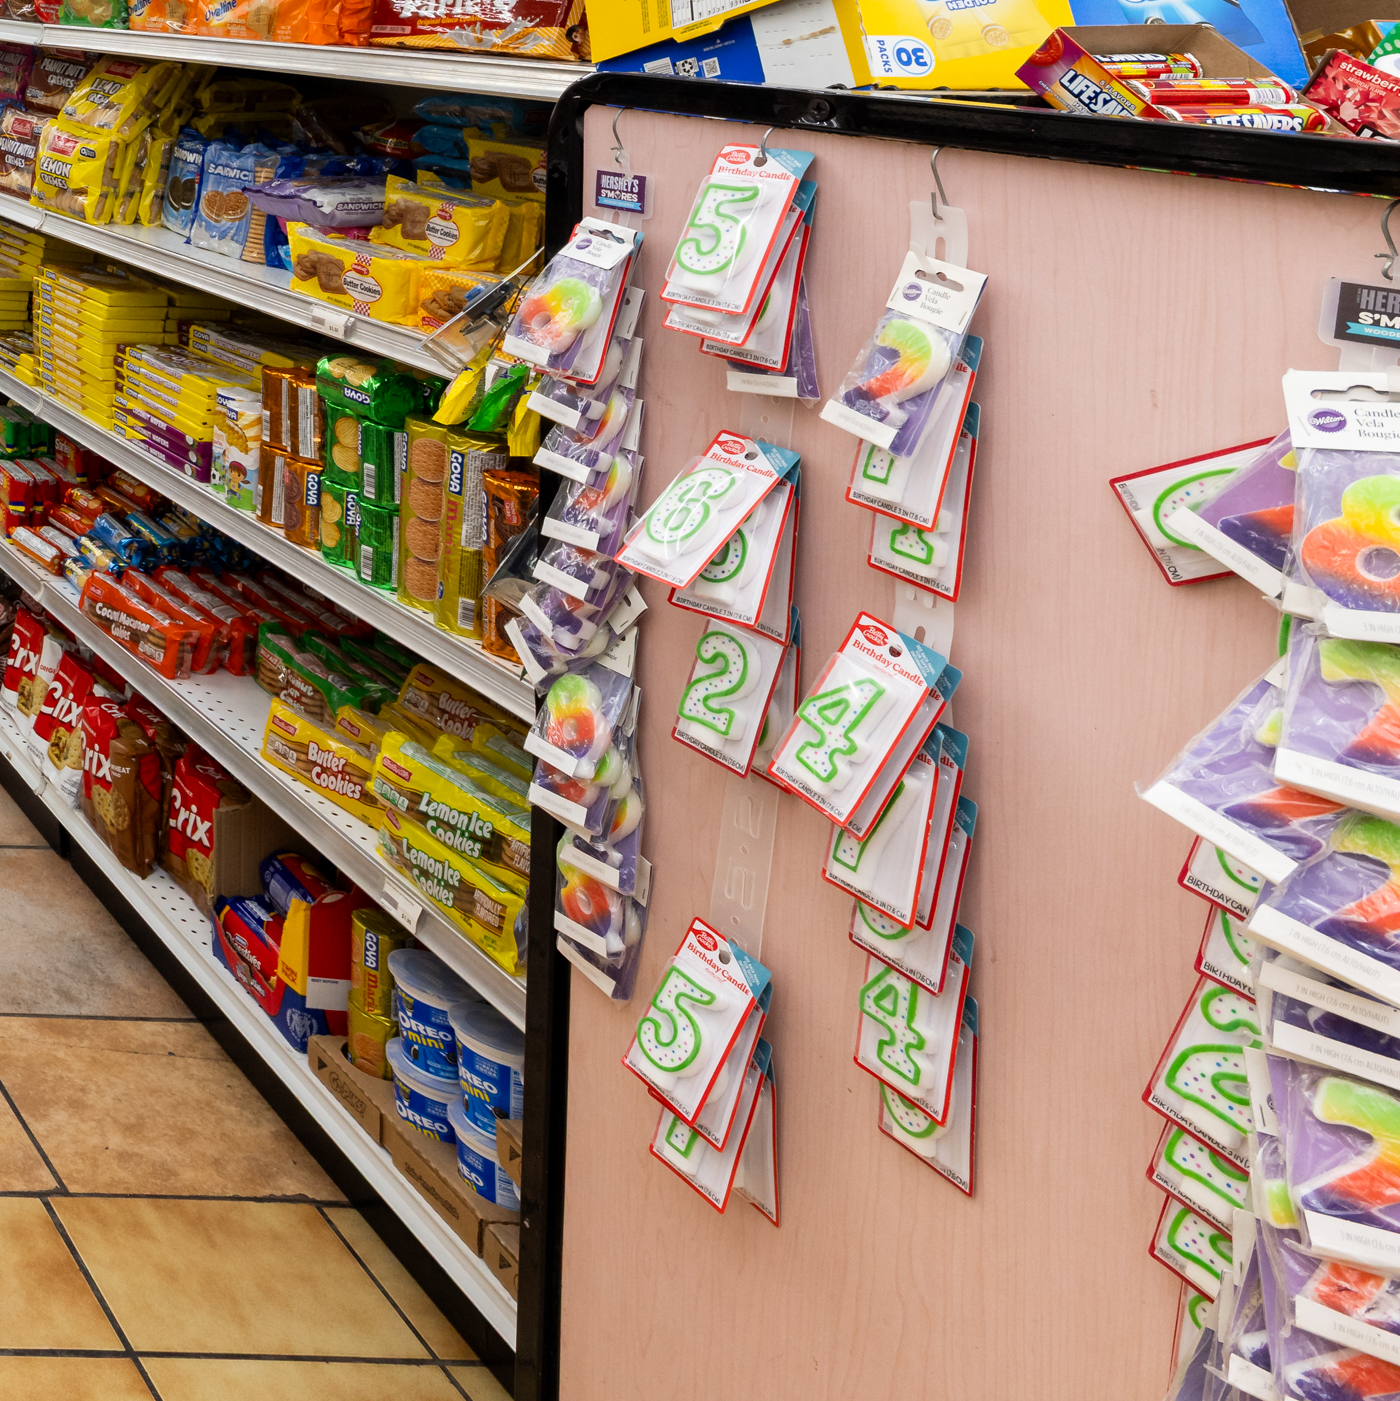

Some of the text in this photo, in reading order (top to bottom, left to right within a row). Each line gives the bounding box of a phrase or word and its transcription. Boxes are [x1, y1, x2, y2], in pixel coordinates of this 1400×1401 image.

[876, 39, 894, 74] PACKS
[1107, 83, 1136, 111] FLAVORS
[40, 157, 72, 179] LEMON
[717, 166, 792, 181] Birthday Candle
[601, 175, 639, 192] HERSHEY'S
[336, 202, 385, 211] SANDWICH
[601, 189, 638, 202] S'MORES
[343, 277, 381, 297] Butter Cookies
[1308, 415, 1346, 427] Wilton
[1356, 419, 1385, 429] Vela
[852, 639, 925, 687] Birthday Candle
[419, 793, 493, 838] Lemon Ice
[426, 819, 483, 859] Cookies
[365, 932, 378, 968] GOYA
[398, 1011, 452, 1044] OREO
[408, 1030, 445, 1053] mini
